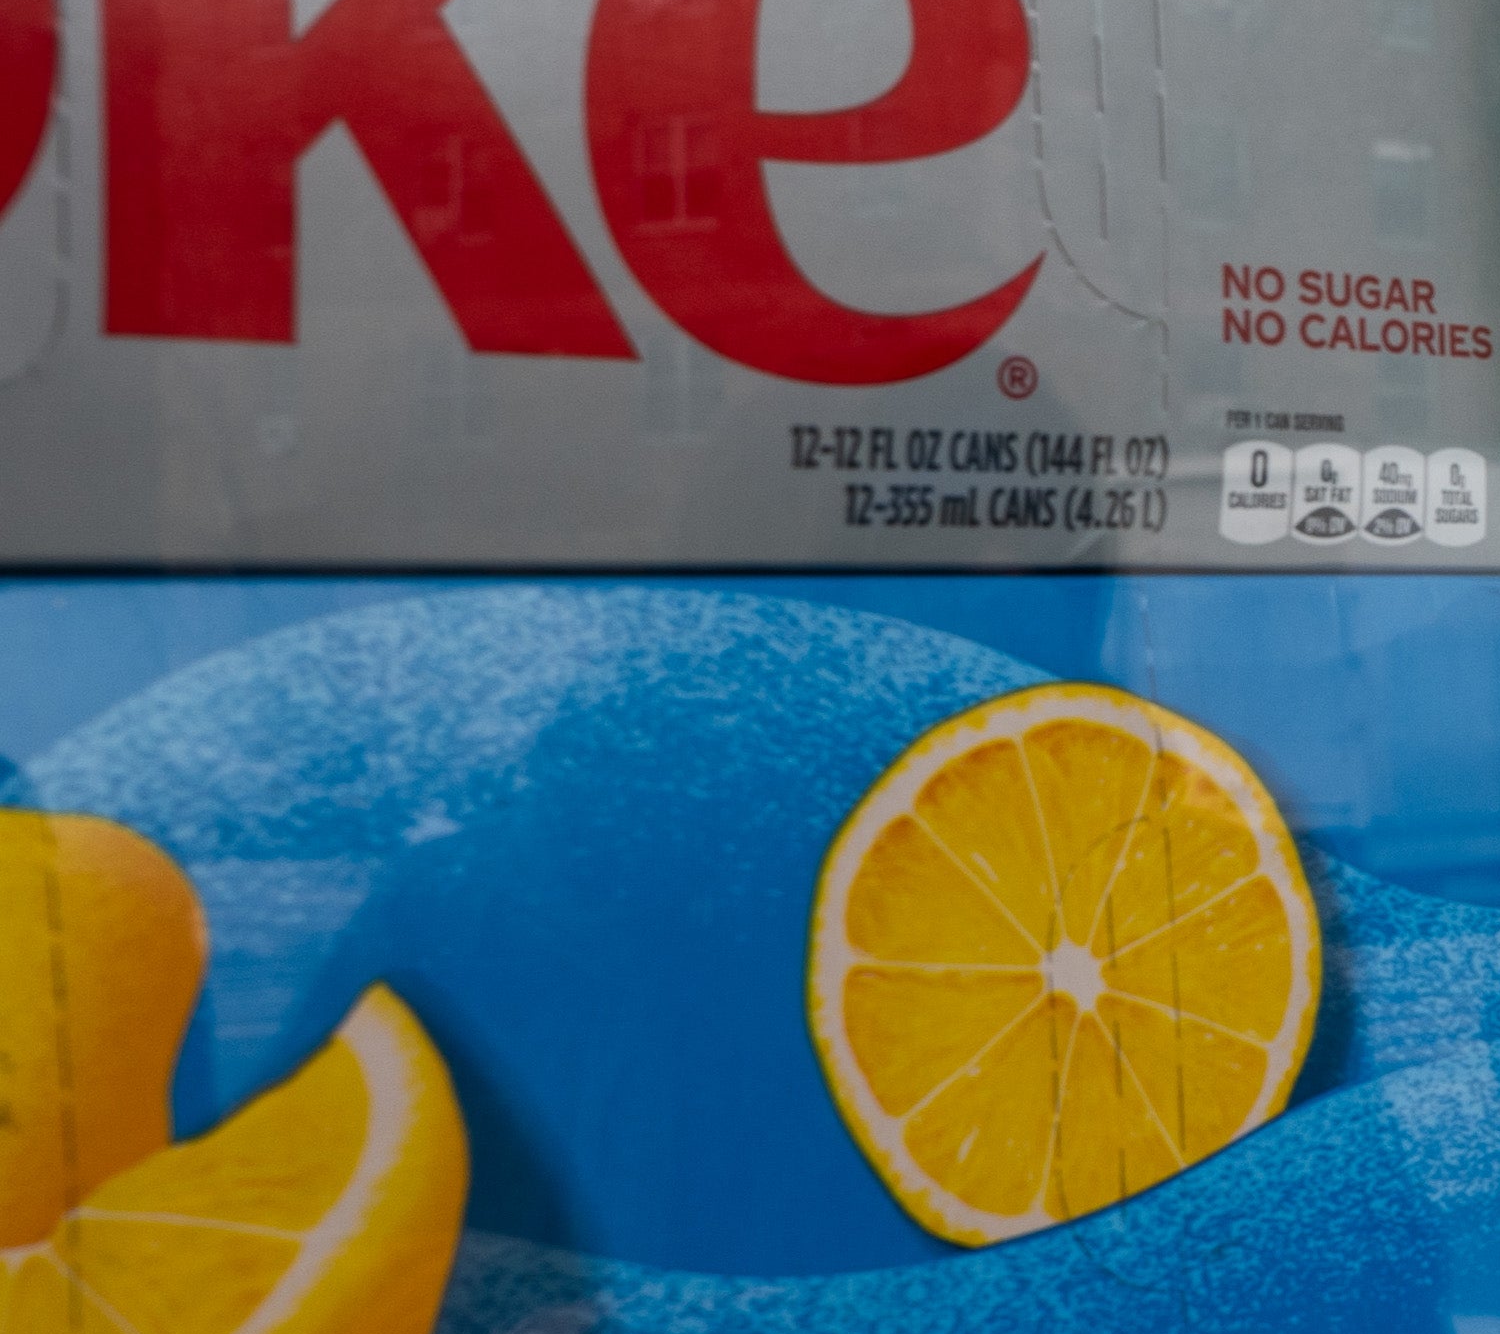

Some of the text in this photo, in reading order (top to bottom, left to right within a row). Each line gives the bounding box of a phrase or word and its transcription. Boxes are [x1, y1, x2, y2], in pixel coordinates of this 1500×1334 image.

[1222, 264, 1436, 315] NO SUGAR
[1222, 308, 1492, 359] NO CALORIES
